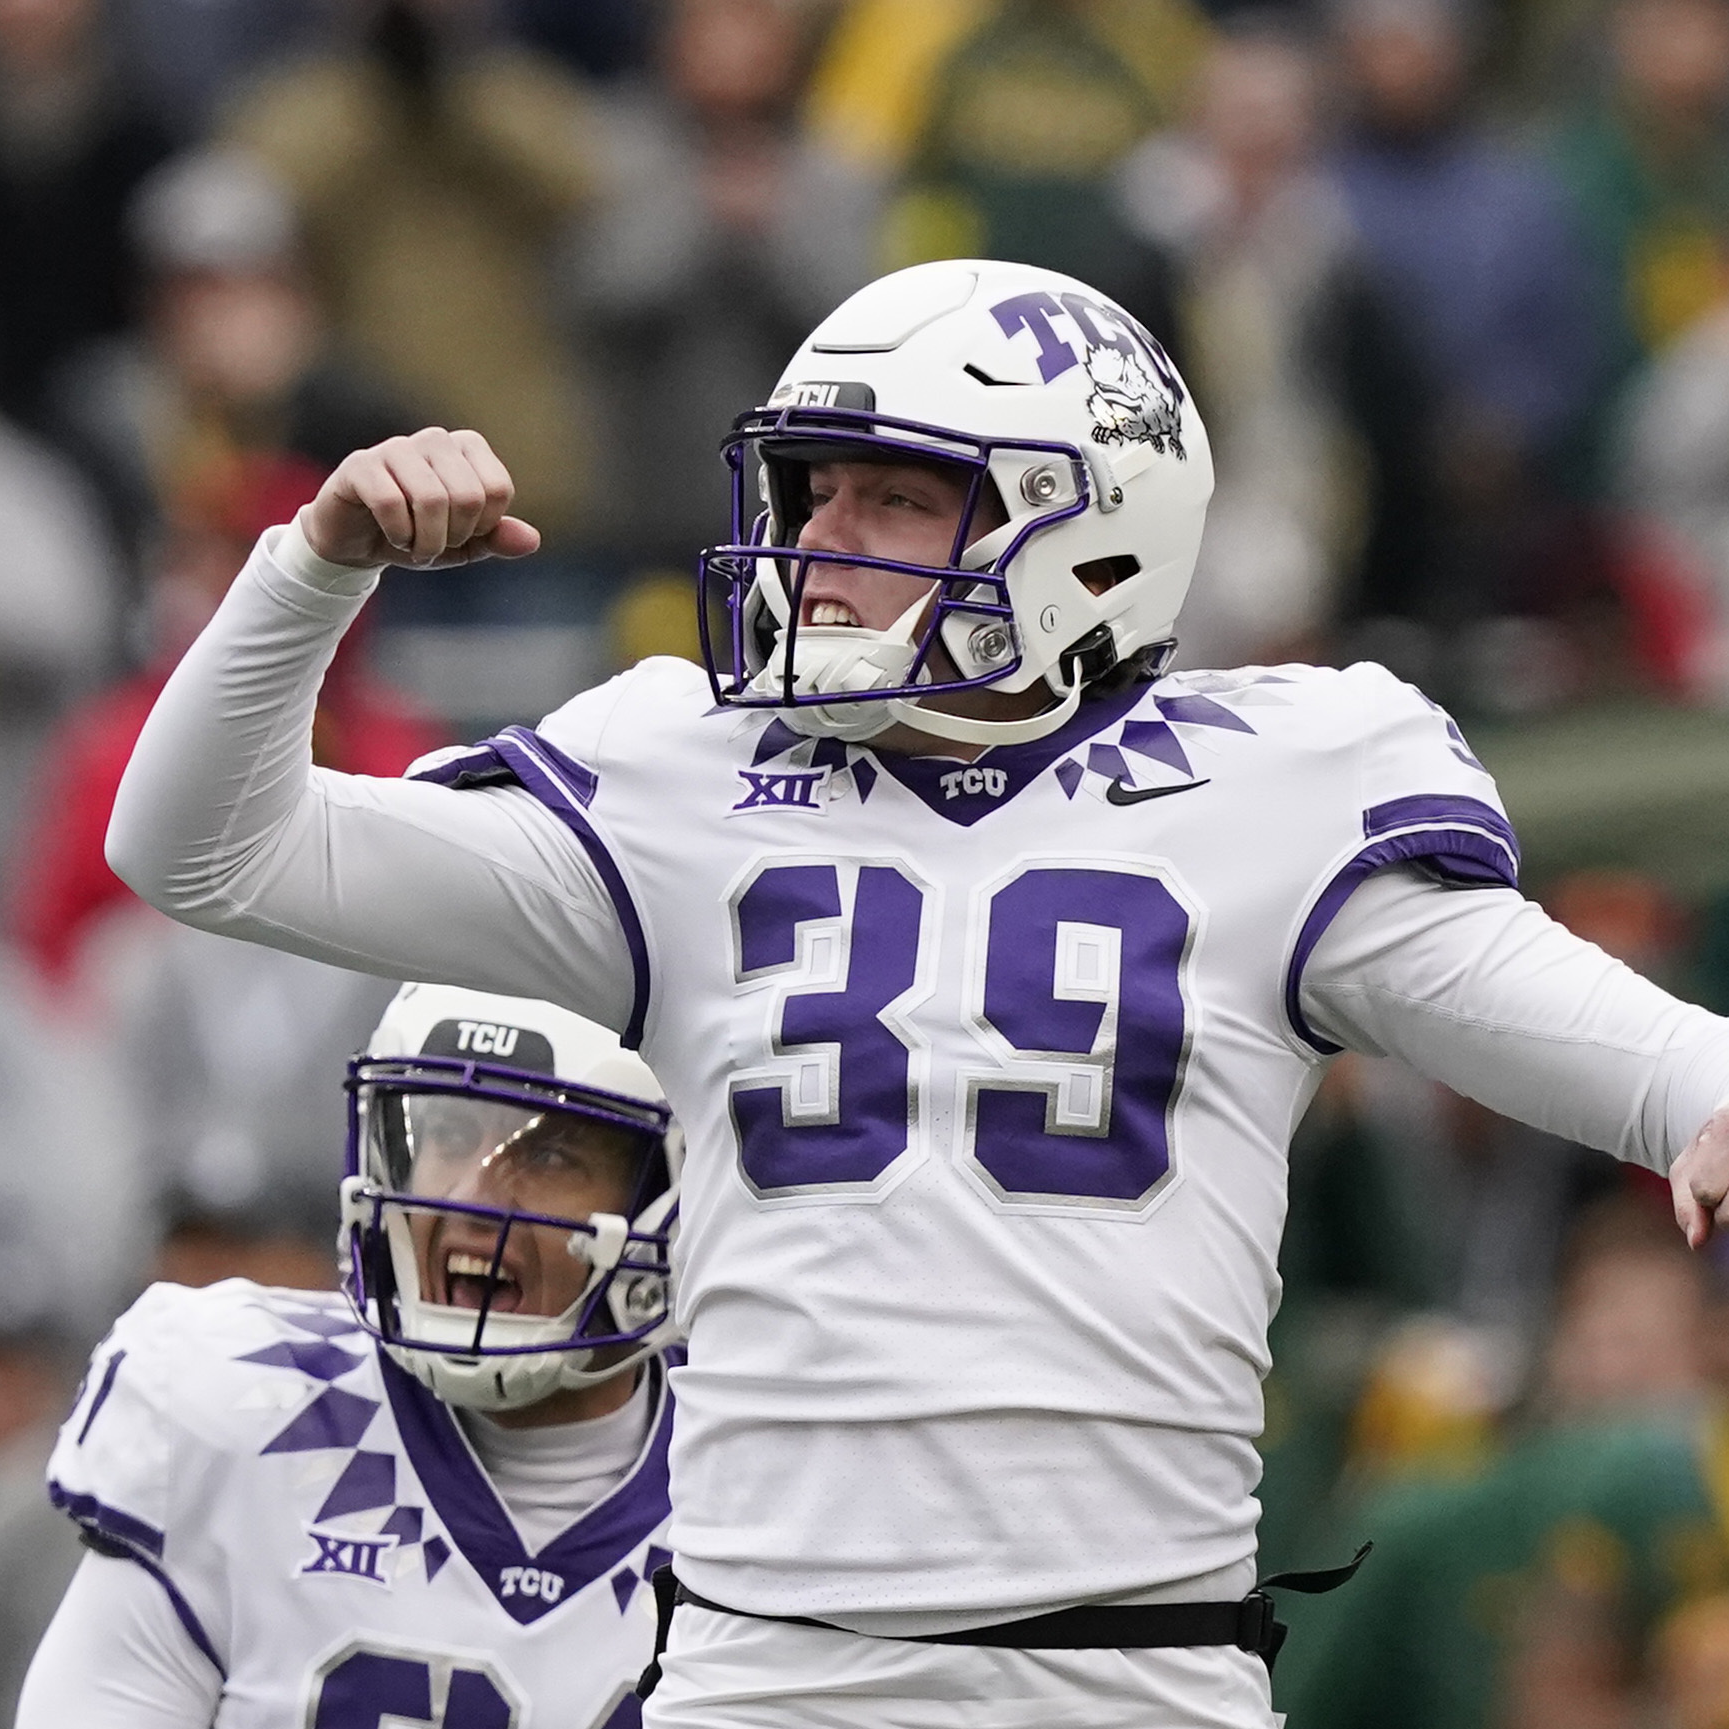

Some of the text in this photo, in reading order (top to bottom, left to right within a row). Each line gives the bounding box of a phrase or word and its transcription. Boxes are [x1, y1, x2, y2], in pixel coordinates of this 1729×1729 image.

[733, 770, 825, 810] XII
[940, 768, 1008, 800] TCU
[457, 1021, 519, 1057] TCU
[725, 857, 1201, 1211] 39
[301, 1532, 391, 1583] XII
[499, 1566, 565, 1603] TCU
